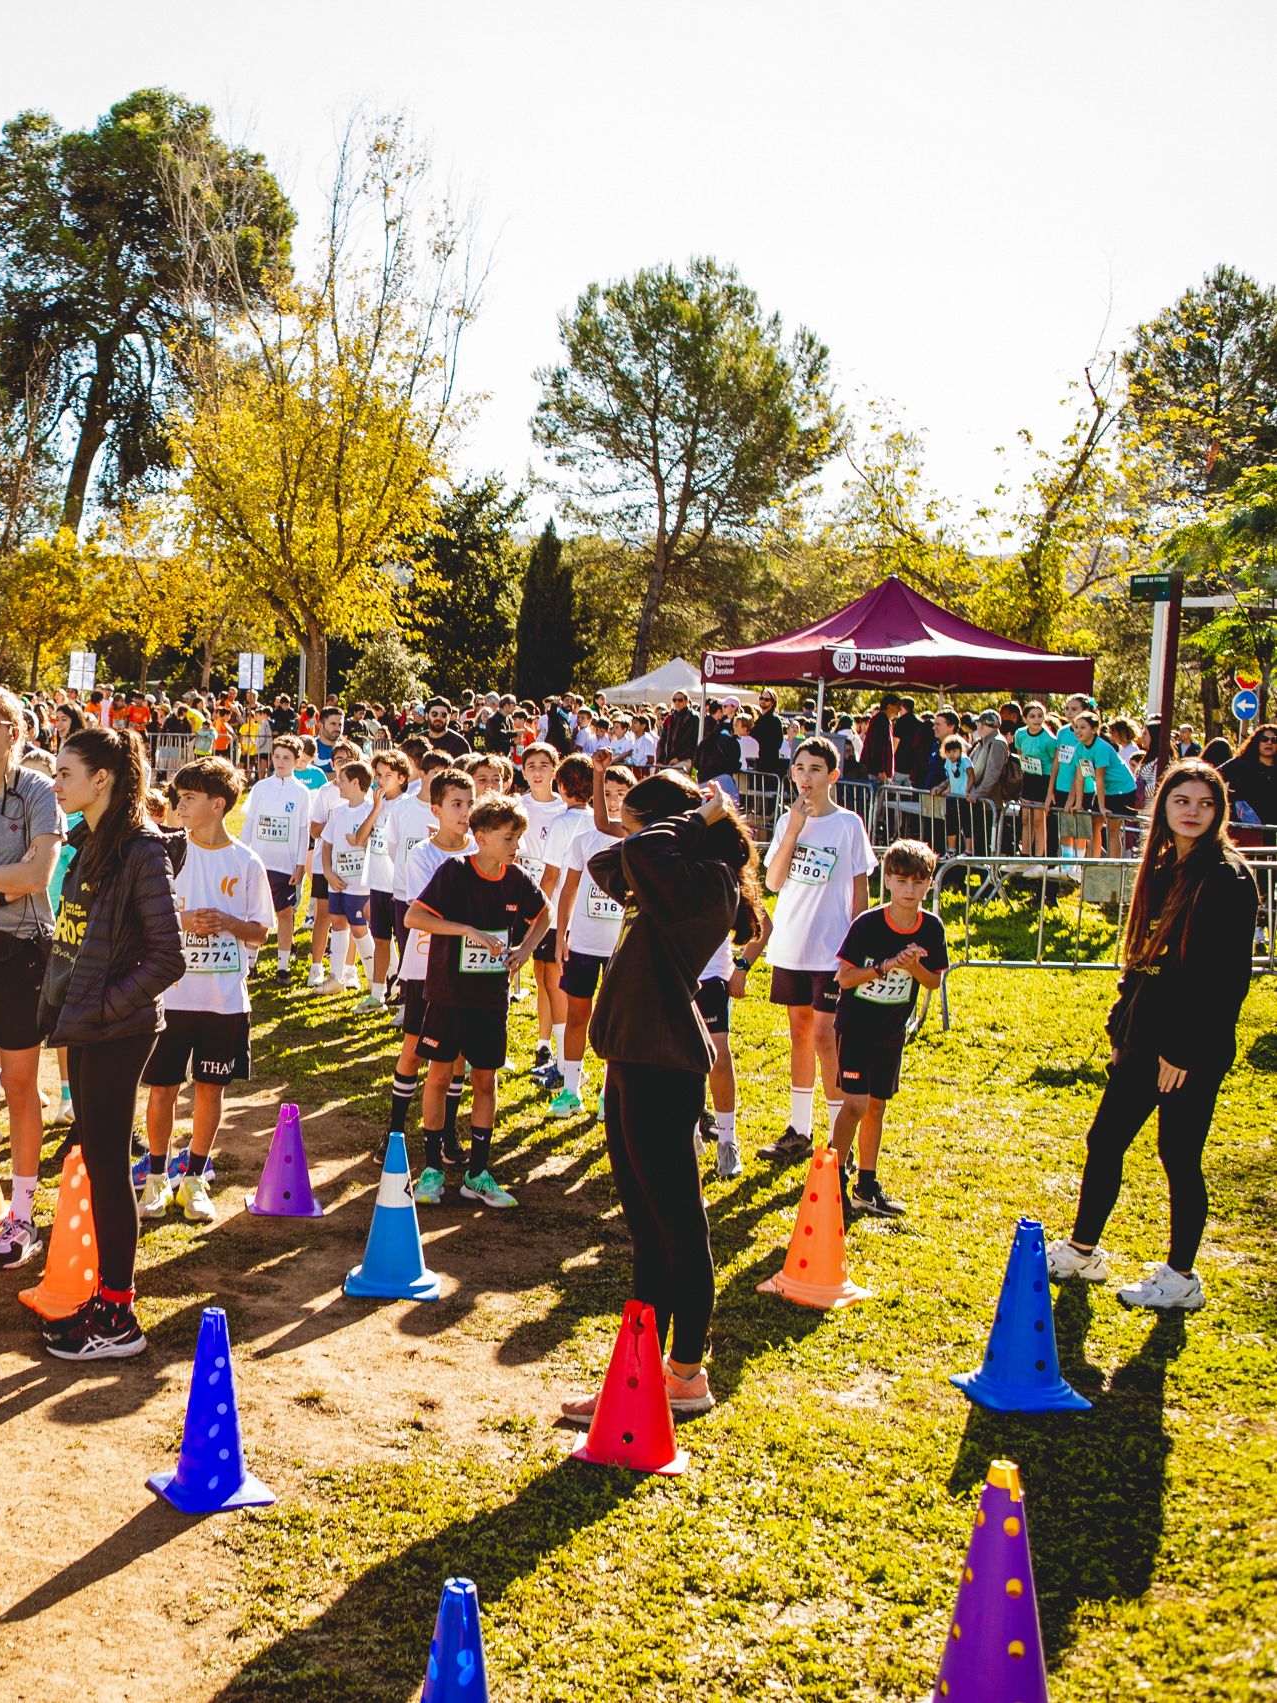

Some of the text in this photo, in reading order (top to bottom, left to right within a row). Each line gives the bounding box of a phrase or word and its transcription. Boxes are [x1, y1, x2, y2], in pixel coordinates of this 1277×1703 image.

[860, 661, 905, 673] Barcelona
[261, 828, 282, 836] 3181
[791, 862, 821, 878] 3180
[190, 951, 231, 963] 2774
[866, 980, 905, 996] 2777
